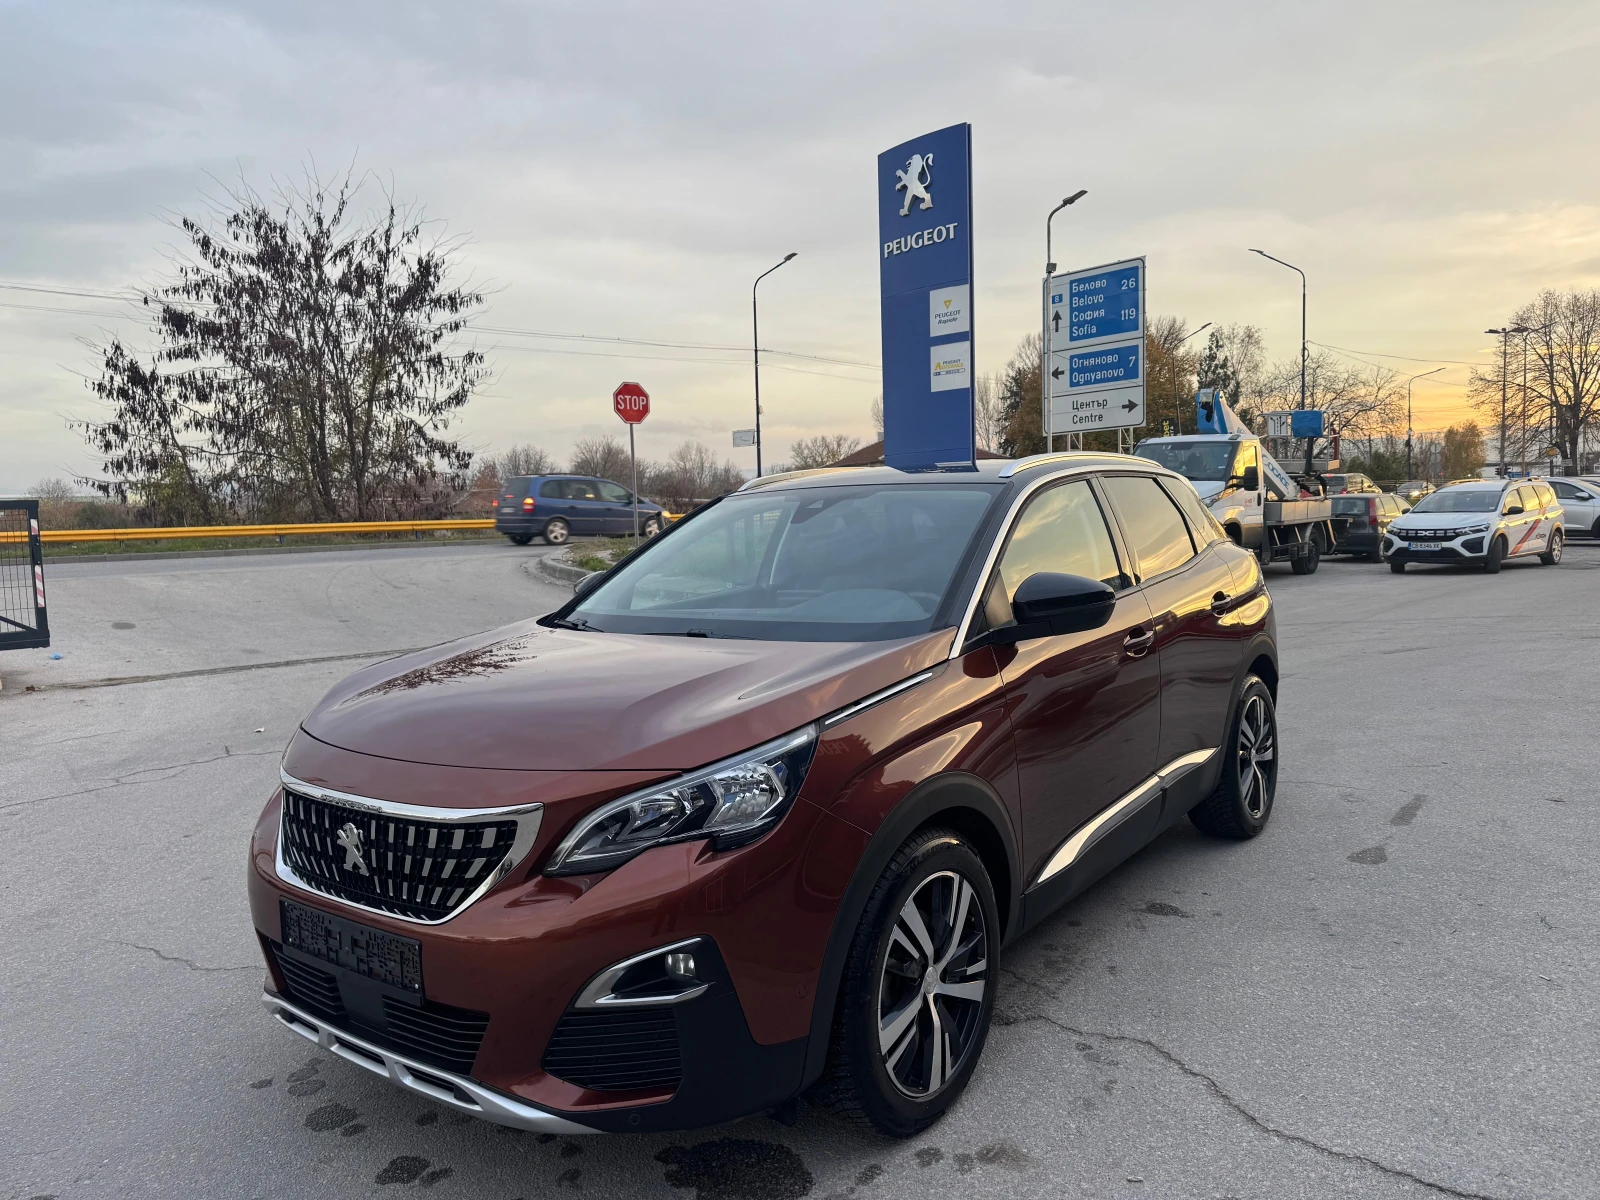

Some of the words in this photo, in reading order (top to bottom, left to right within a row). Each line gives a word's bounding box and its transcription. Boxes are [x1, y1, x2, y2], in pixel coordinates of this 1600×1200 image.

[884, 222, 958, 259] PEUGEOT
[1072, 279, 1107, 293] Белово
[1121, 278, 1136, 290] 26
[1072, 293, 1104, 308] Belovo
[934, 309, 961, 320] PEUGEOT
[1072, 308, 1105, 323] София
[1120, 308, 1136, 321] 119
[1072, 324, 1097, 337] Sofia
[1072, 354, 1119, 369] Огняново
[1128, 356, 1136, 368] 7
[1072, 367, 1125, 385] Ognyanovo
[617, 394, 647, 411] STOP
[1072, 398, 1108, 412] Център
[1072, 413, 1104, 425] Centre
